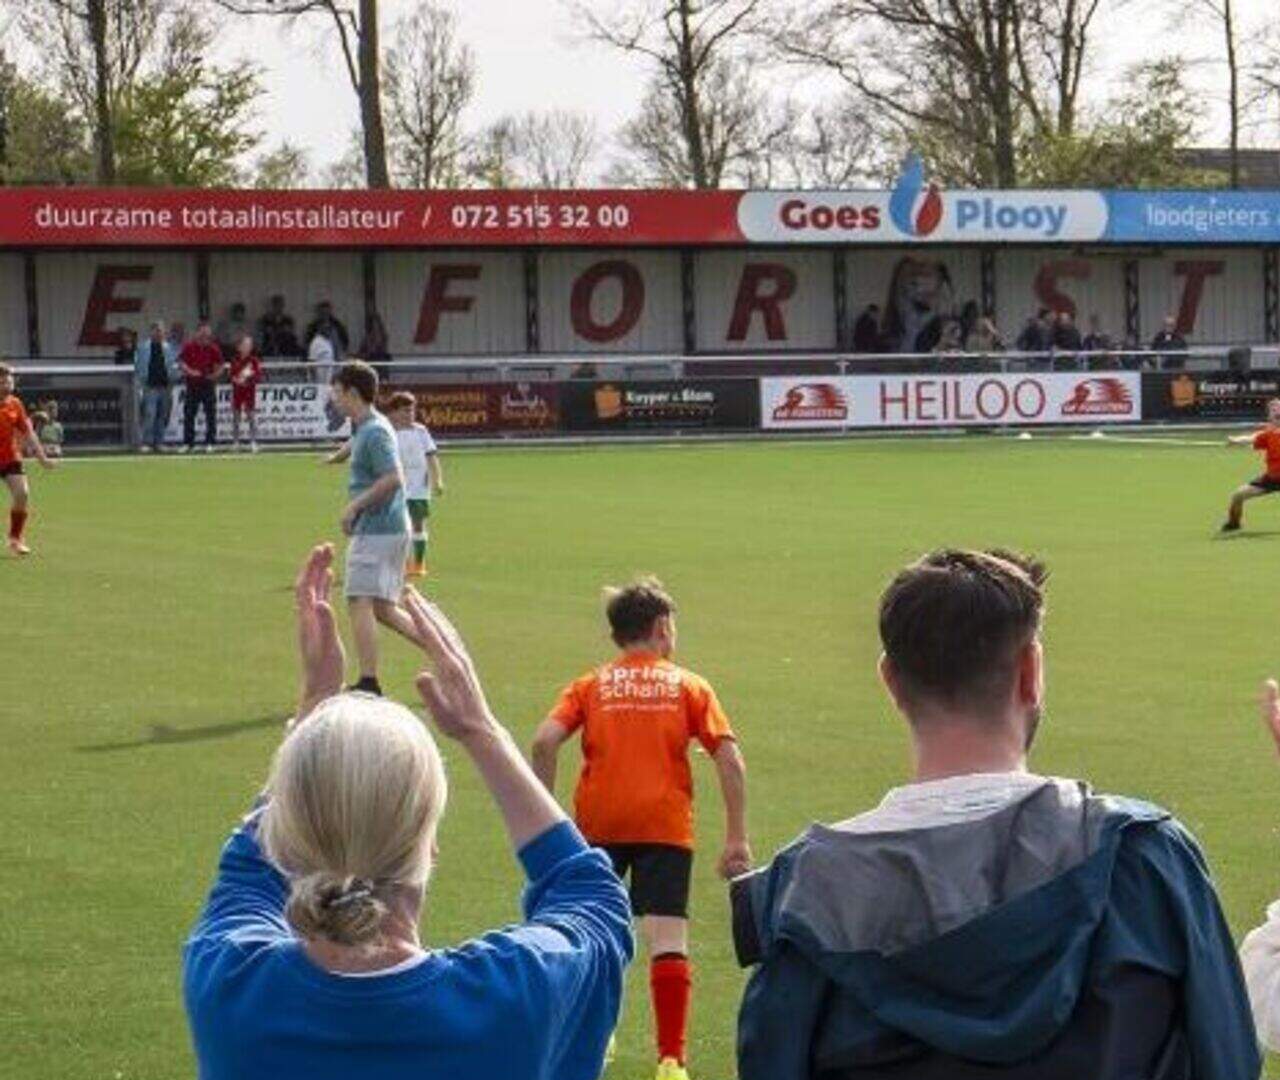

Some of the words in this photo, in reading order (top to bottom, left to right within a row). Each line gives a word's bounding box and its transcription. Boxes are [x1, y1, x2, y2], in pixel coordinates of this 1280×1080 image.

[34, 203, 173, 227] duurzame
[181, 204, 404, 229] totaalinstallateur
[451, 206, 499, 227] 072
[507, 206, 552, 227] 515
[560, 206, 591, 227] 32
[598, 206, 630, 227] 00
[780, 199, 881, 230] Goes
[956, 199, 1067, 236] Plooy
[1146, 204, 1269, 231] loodgieters
[879, 378, 1047, 421] HEILOO
[599, 663, 681, 684] spring
[600, 681, 679, 700] schans
